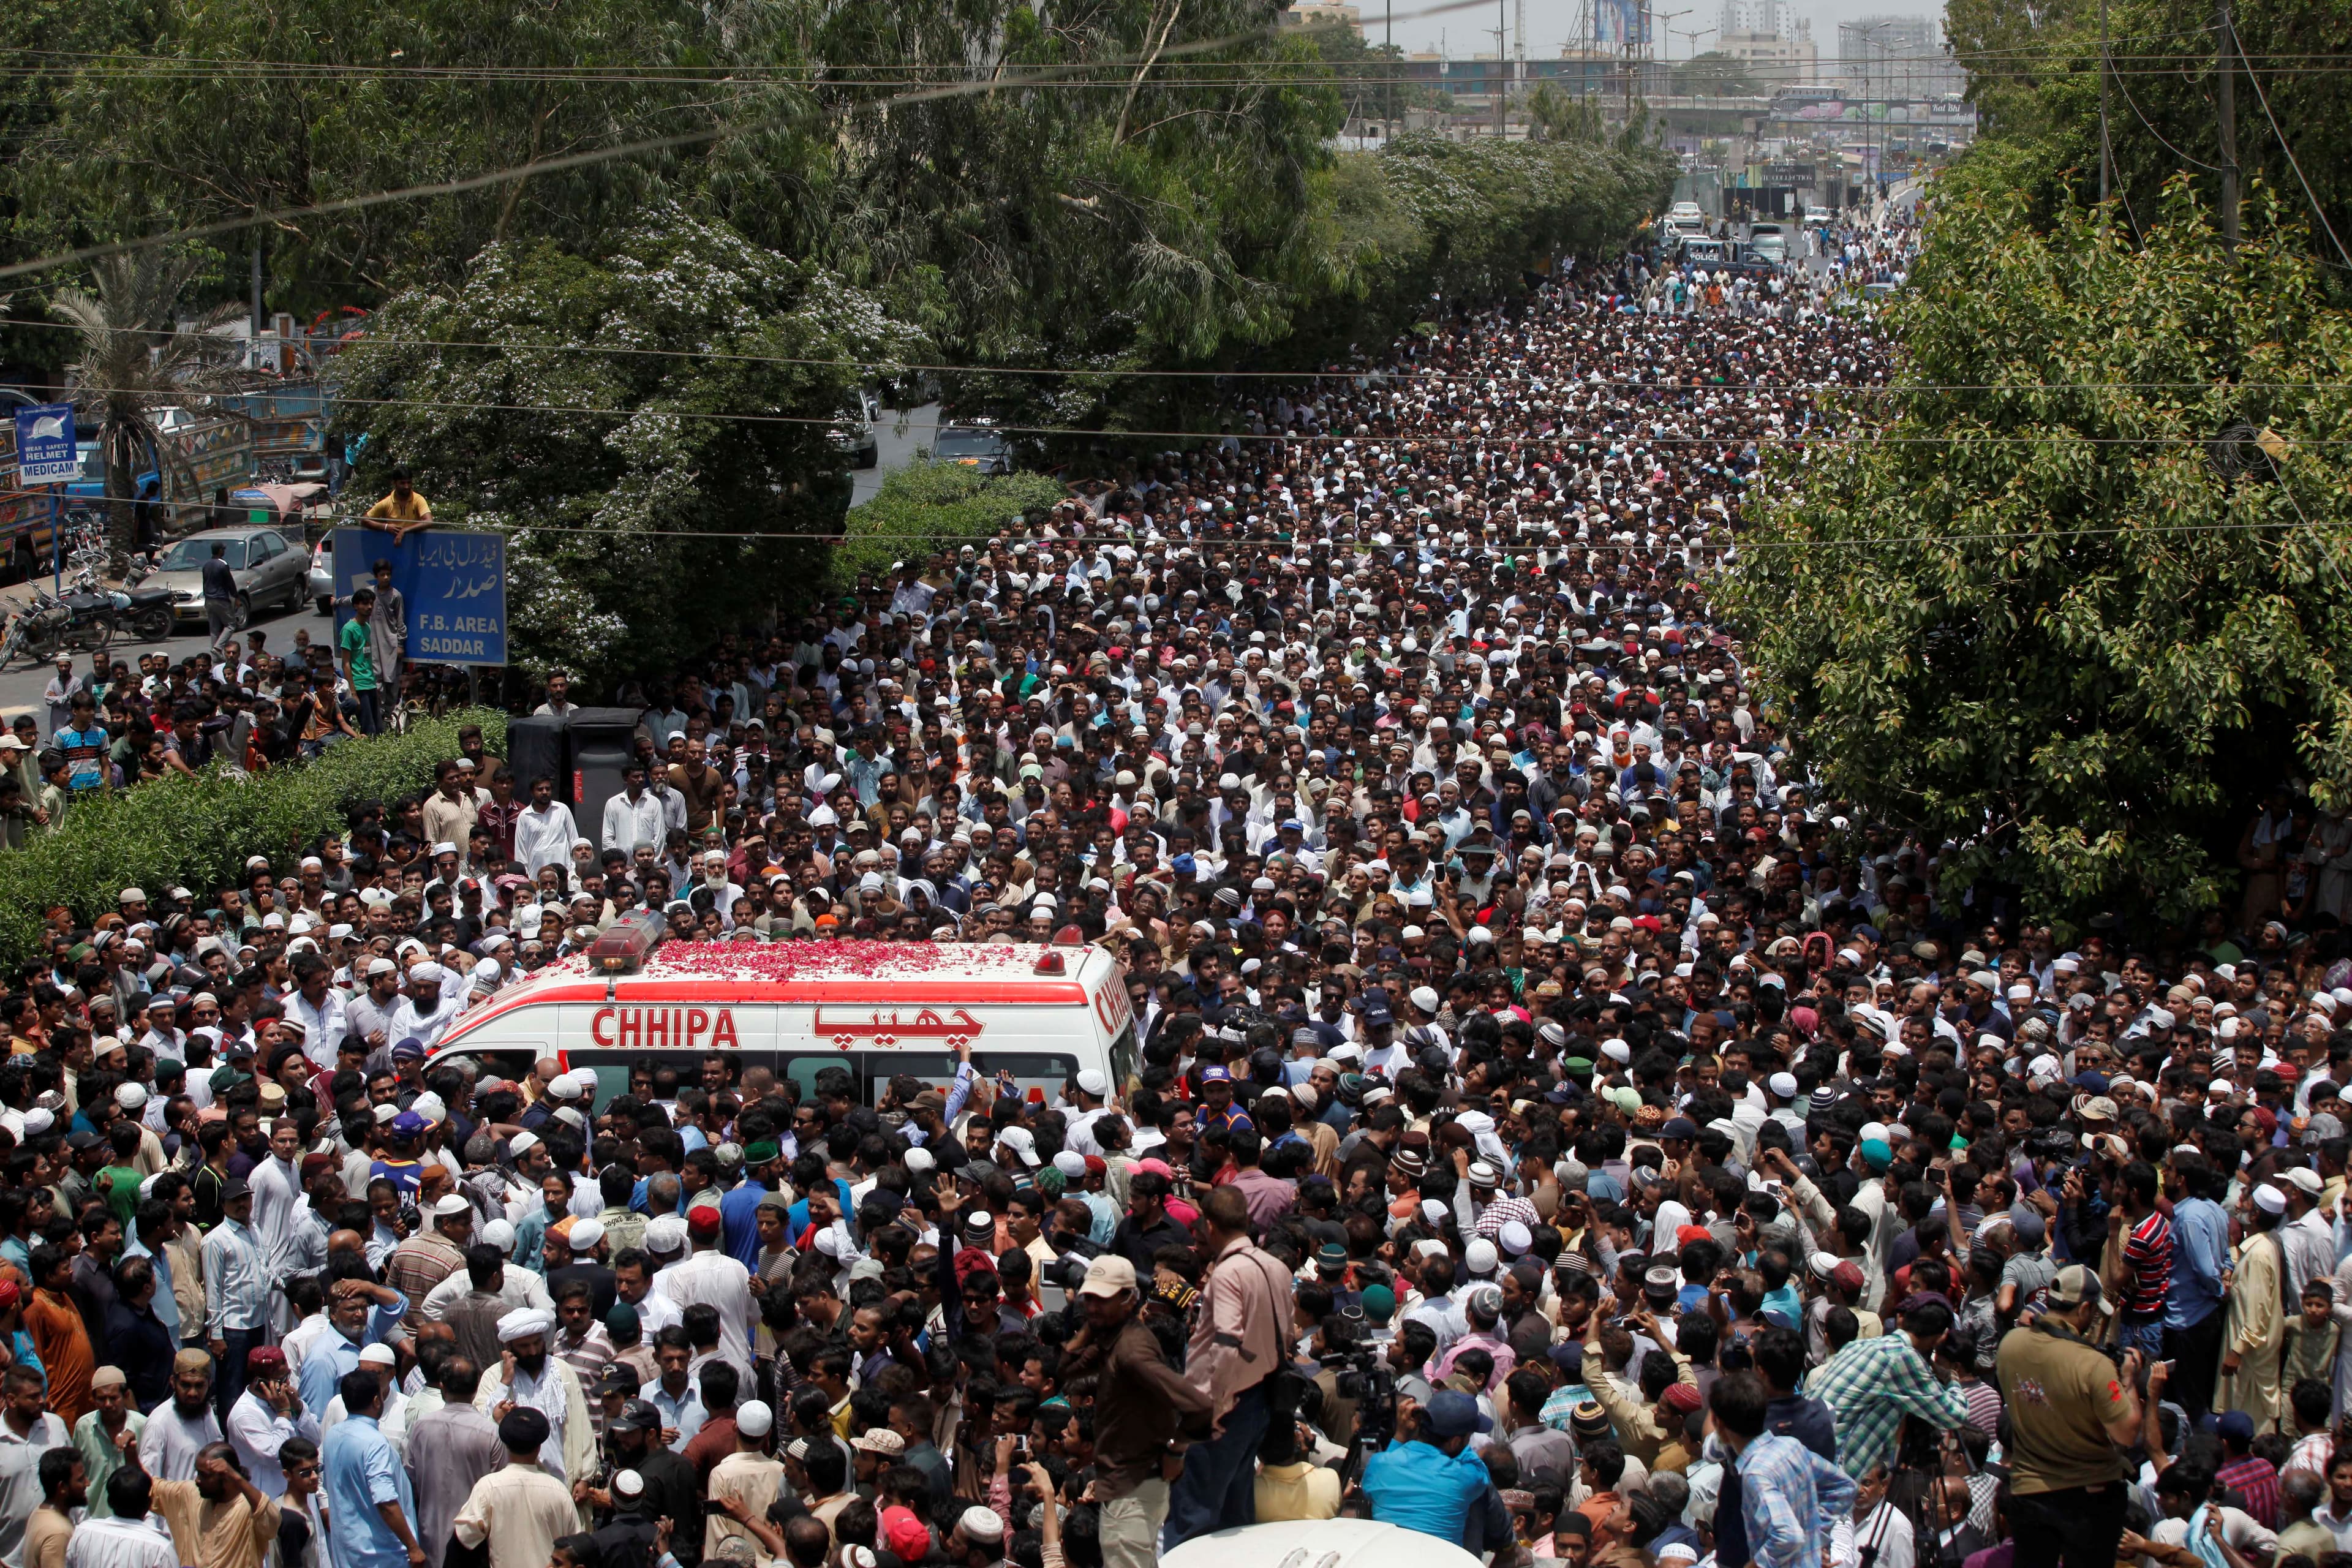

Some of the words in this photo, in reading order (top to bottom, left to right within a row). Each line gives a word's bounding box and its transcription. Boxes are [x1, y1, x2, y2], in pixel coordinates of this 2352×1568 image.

[26, 450, 68, 461] HELMET
[24, 462, 74, 477] MEDICAM
[442, 573, 498, 600] صدر
[420, 615, 449, 631] F.B.
[454, 617, 499, 634] AREA
[421, 637, 484, 655] SADDAR
[590, 1006, 742, 1049] CHHIPA
[812, 1005, 987, 1051] چھیپا
